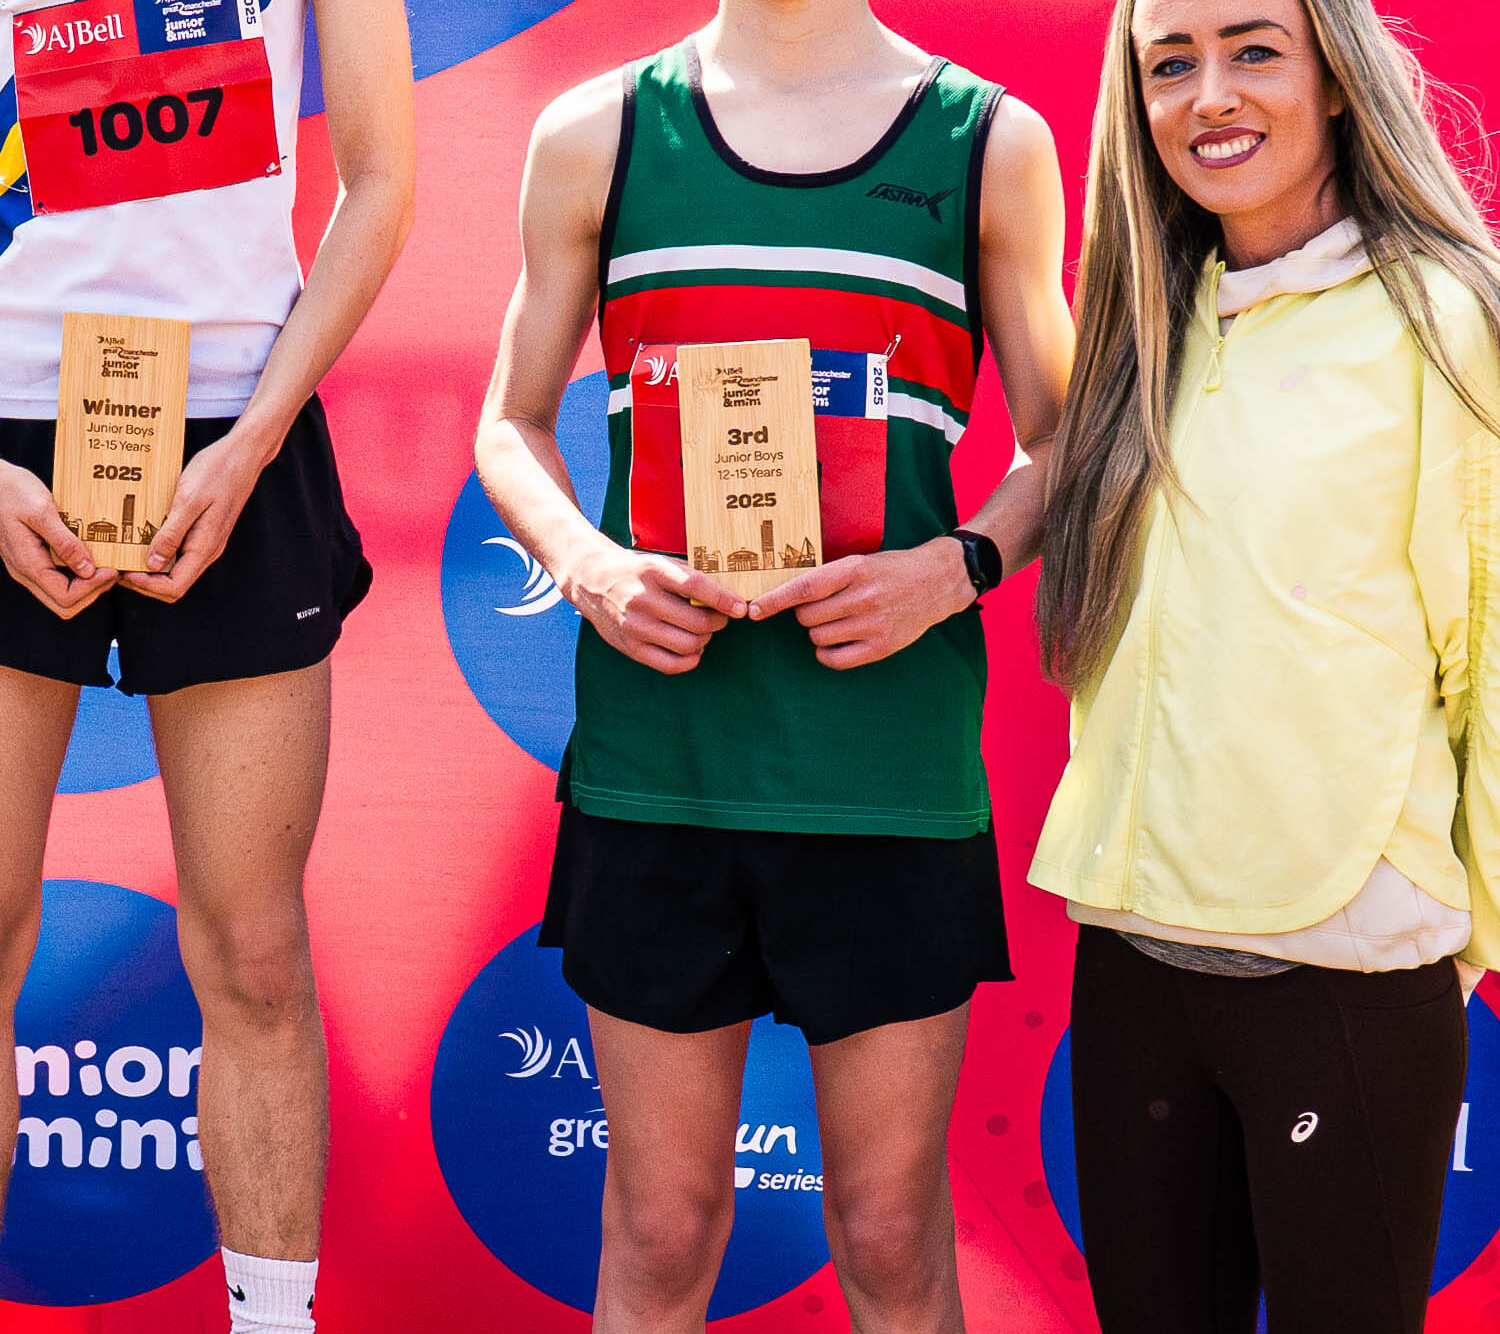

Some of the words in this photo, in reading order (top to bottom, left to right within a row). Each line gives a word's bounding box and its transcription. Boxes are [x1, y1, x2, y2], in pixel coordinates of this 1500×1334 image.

[164, 17, 205, 32] junior
[46, 13, 125, 54] AJBell
[68, 87, 224, 156] 1007
[102, 356, 140, 370] junior
[722, 388, 760, 399] junior
[873, 367, 884, 406] 2025
[83, 398, 163, 420] Winner
[86, 422, 124, 436] Junior
[126, 424, 155, 438] Boys
[727, 426, 769, 446] 3rd
[87, 438, 118, 452] 12-15
[118, 441, 152, 454] Years
[714, 452, 752, 464] Junior
[754, 450, 784, 464] Boys
[92, 464, 143, 482] 2025
[717, 469, 748, 480] 12-15
[749, 467, 783, 479] Years
[726, 492, 777, 509] 2025
[15, 1039, 204, 1098] nior
[548, 1118, 609, 1157] gre
[735, 1123, 797, 1155] un
